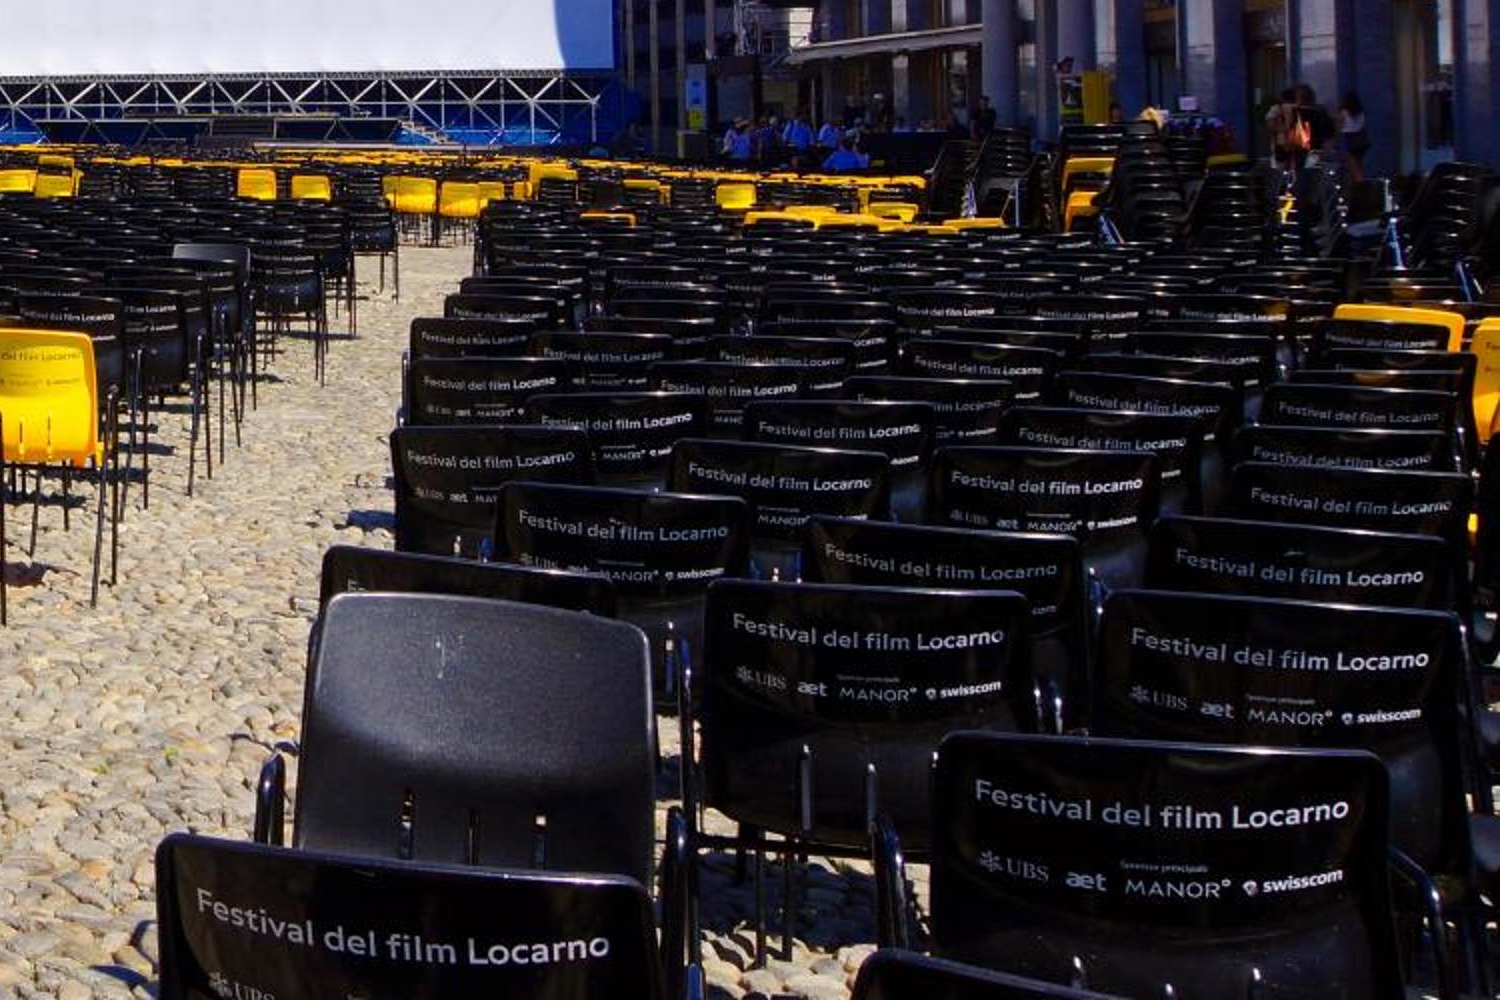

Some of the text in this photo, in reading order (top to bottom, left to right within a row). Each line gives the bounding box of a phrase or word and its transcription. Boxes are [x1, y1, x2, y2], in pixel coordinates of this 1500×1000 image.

[512, 377, 556, 390] Locarno
[753, 384, 797, 397] Locarno
[592, 412, 693, 431] del film Locarno
[1335, 411, 1356, 423] del
[1359, 412, 1386, 425] film
[1389, 412, 1438, 424] Locarno
[813, 425, 837, 439] del
[838, 426, 865, 440] film
[868, 423, 921, 439] Locarno
[1077, 436, 1101, 449] del
[1104, 437, 1132, 450] film
[1135, 436, 1186, 450] Locarno
[459, 452, 481, 468] del
[483, 453, 513, 469] film
[517, 452, 574, 468] Locarno
[1377, 453, 1431, 468] Locarno
[688, 462, 872, 492] Festival del film Locarno
[951, 470, 1143, 495] Festival del film Locarno
[1251, 487, 1452, 515] Festival del film Locarno
[518, 509, 728, 542] Festival del film Locarno
[825, 542, 1058, 581] Festival del film Locarno
[1176, 548, 1424, 588] Festival del film Locarno
[733, 613, 1003, 651] Festival del film Locarno
[1131, 627, 1429, 672] Festival del film Locarno
[940, 681, 1002, 699] swisscom
[1357, 708, 1422, 724] swisscom
[975, 779, 1350, 830] Festival del film Locarno
[1006, 857, 1050, 883] UBS
[1263, 868, 1343, 893] swisscom
[196, 887, 610, 966] Festival del film Locarno
